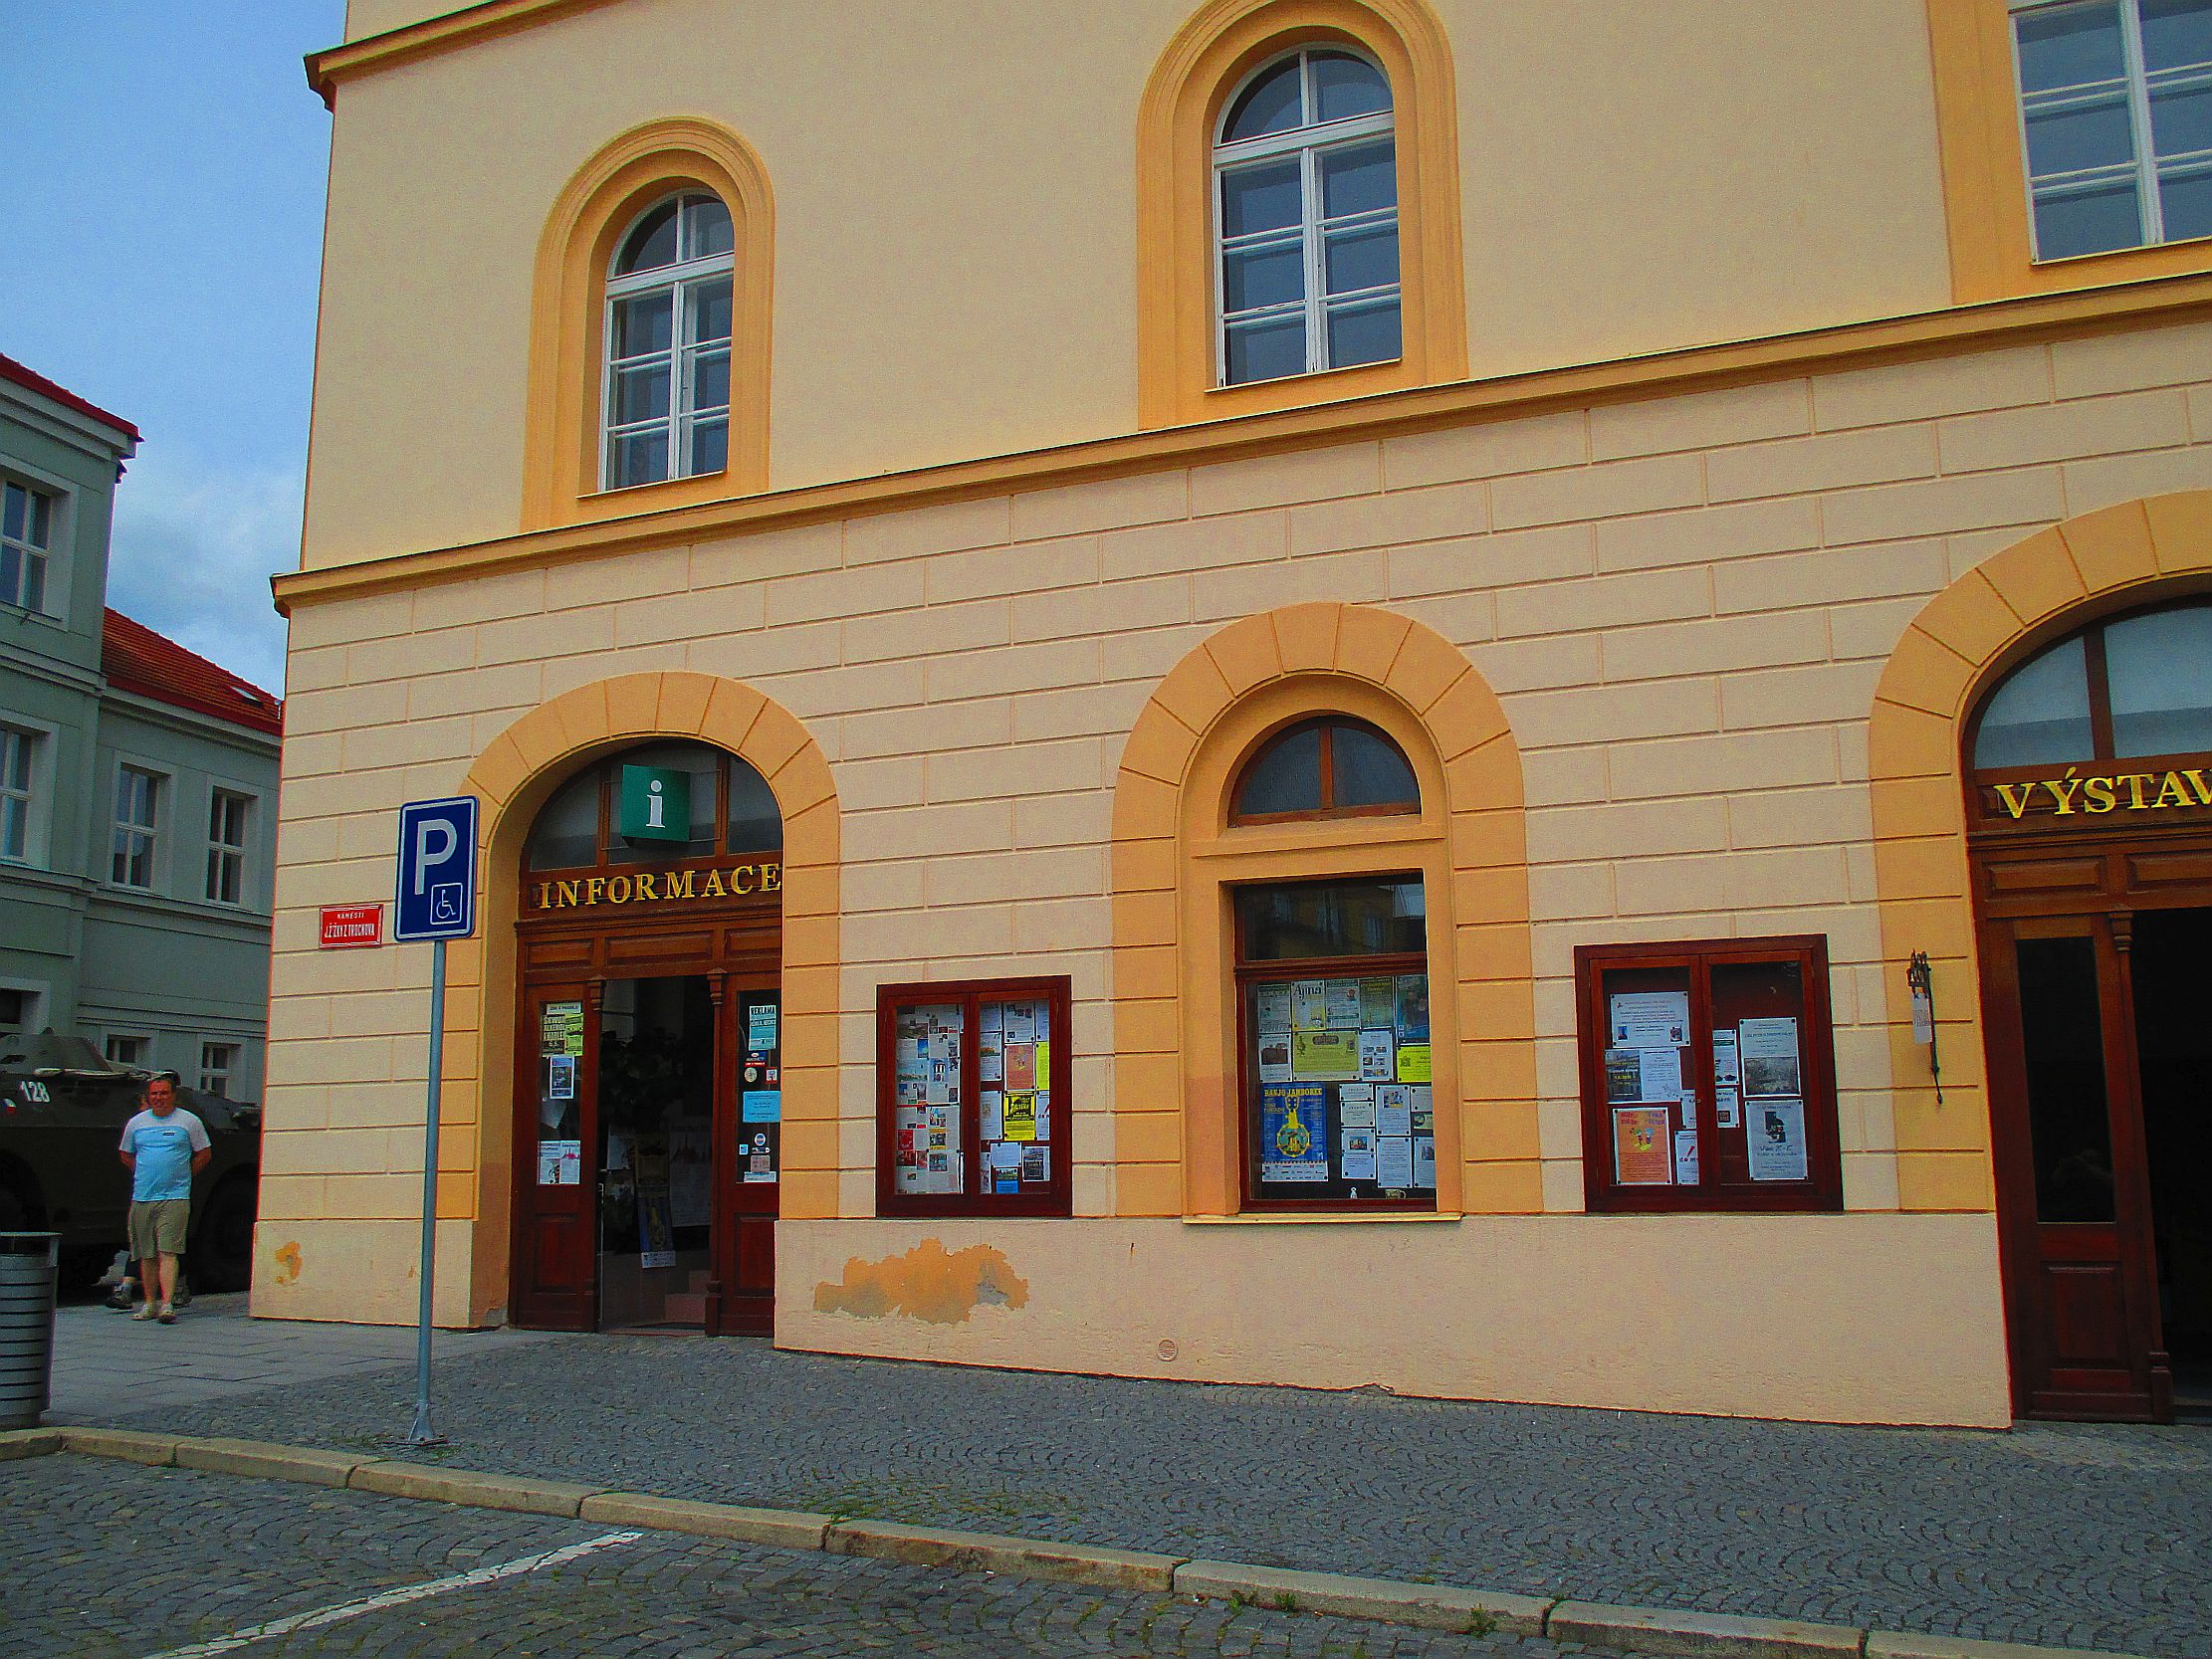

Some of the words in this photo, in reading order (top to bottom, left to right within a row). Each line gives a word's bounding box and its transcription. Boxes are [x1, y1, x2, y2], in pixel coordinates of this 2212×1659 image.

[414, 818, 458, 896] P
[539, 863, 781, 910] INFORMACE
[19, 1081, 50, 1102] 128
